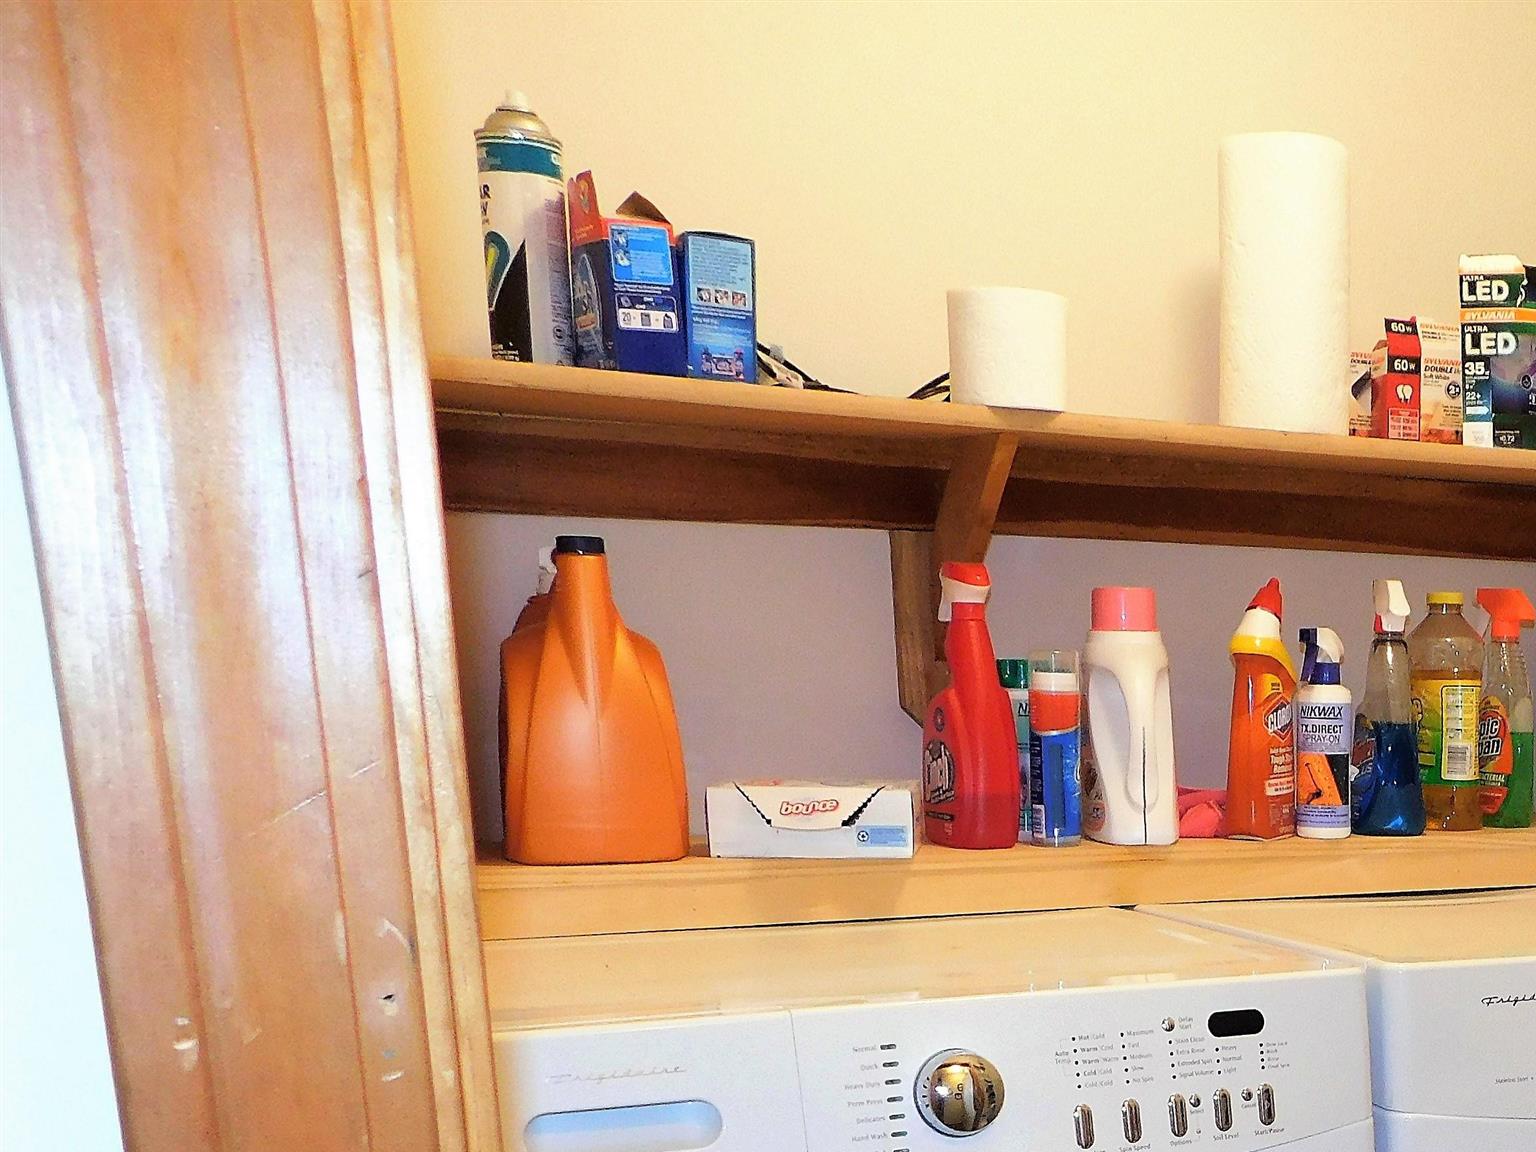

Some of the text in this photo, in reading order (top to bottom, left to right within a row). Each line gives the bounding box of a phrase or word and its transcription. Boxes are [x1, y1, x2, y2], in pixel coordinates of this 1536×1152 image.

[1462, 280, 1510, 302] LED
[1464, 311, 1516, 320] SYLVANIA
[1464, 325, 1488, 333] ULTRA
[1465, 332, 1517, 355] LED
[1301, 706, 1343, 718] NIKWAX
[1300, 724, 1344, 734] TX.DIRECT
[780, 800, 839, 815] bounce
